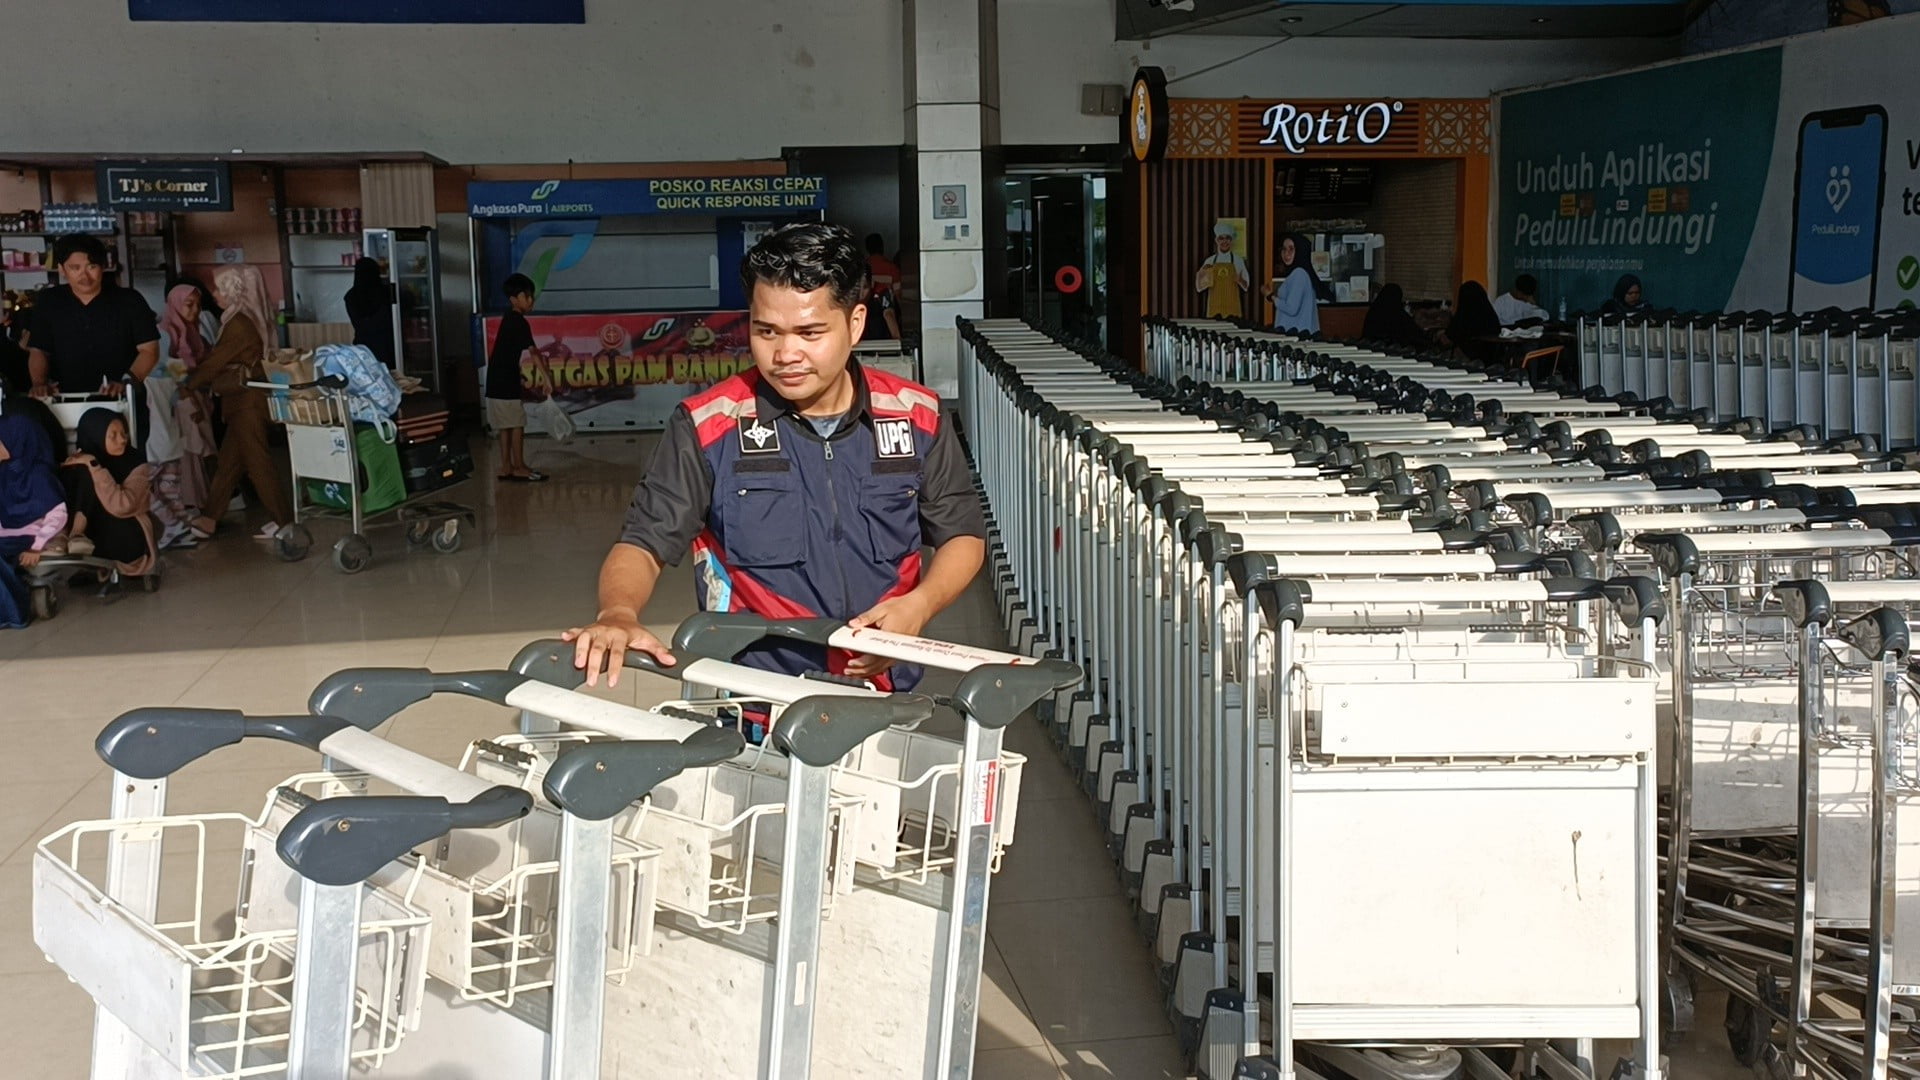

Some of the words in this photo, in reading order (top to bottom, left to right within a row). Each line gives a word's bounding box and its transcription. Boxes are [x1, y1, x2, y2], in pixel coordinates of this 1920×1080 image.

[1516, 151, 1594, 194] Unduh
[1600, 138, 1712, 196] Aplikasi
[118, 178, 152, 193] TJ's
[155, 179, 208, 193] Corner
[649, 179, 706, 193] POSKO
[710, 178, 768, 192] REAKSI
[773, 177, 823, 191] CEPAT
[550, 203, 594, 213] AIRPORTS
[657, 196, 701, 209] QUICK
[705, 195, 781, 208] RESPONSE
[785, 194, 817, 207] UNIT
[1514, 201, 1719, 255] PeduliLindungi
[520, 354, 610, 389] SATGAS
[614, 355, 668, 387] PAM
[876, 421, 911, 455] UPG
